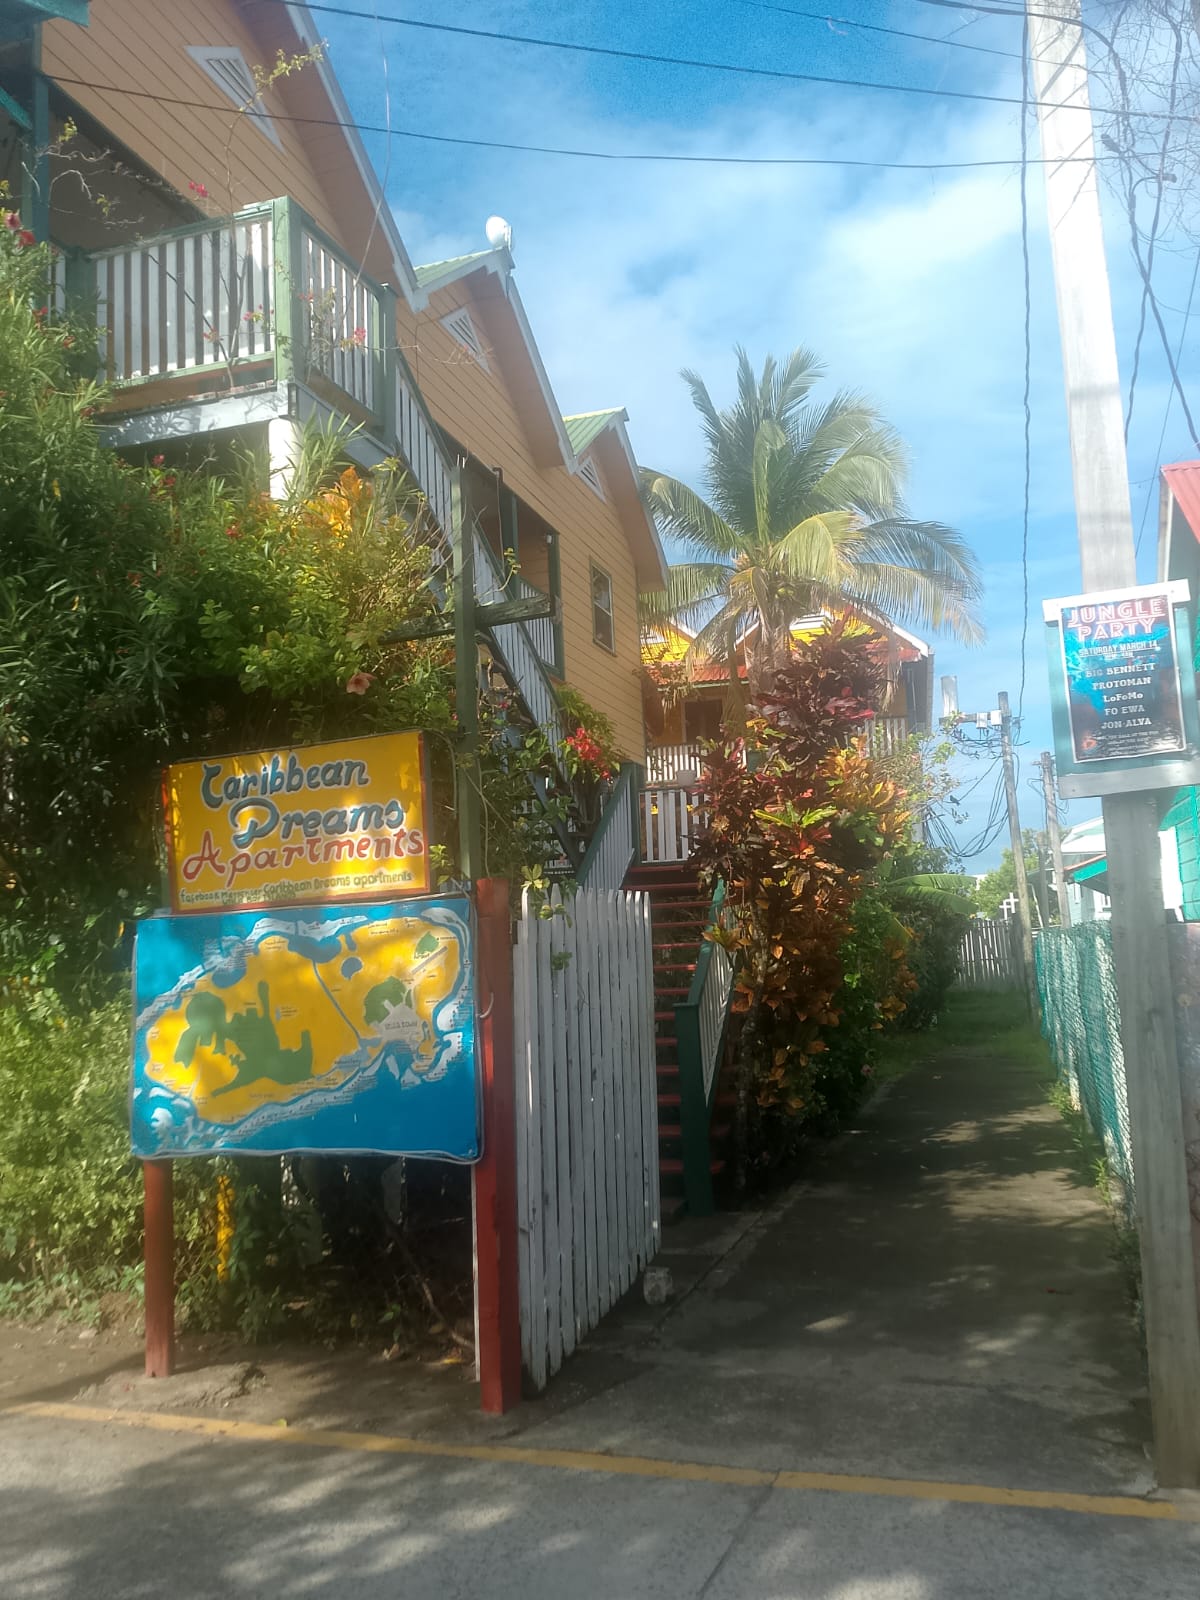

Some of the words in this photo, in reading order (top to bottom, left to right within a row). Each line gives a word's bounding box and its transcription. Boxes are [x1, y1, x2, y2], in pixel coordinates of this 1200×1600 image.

[1069, 598, 1164, 627] JUNGLE
[1078, 618, 1156, 641] PARTY
[1078, 646, 1118, 656] SATURDAY
[1119, 641, 1147, 652] MARCH
[1106, 663, 1156, 676] BENNETT
[1091, 677, 1152, 690] PROTOMAN
[1121, 705, 1145, 714] EWA
[200, 755, 369, 809] Caribbean
[230, 798, 405, 848] Dreams
[182, 829, 425, 887] Apartments
[263, 880, 312, 895] Caribbean
[353, 871, 412, 888] apartments
